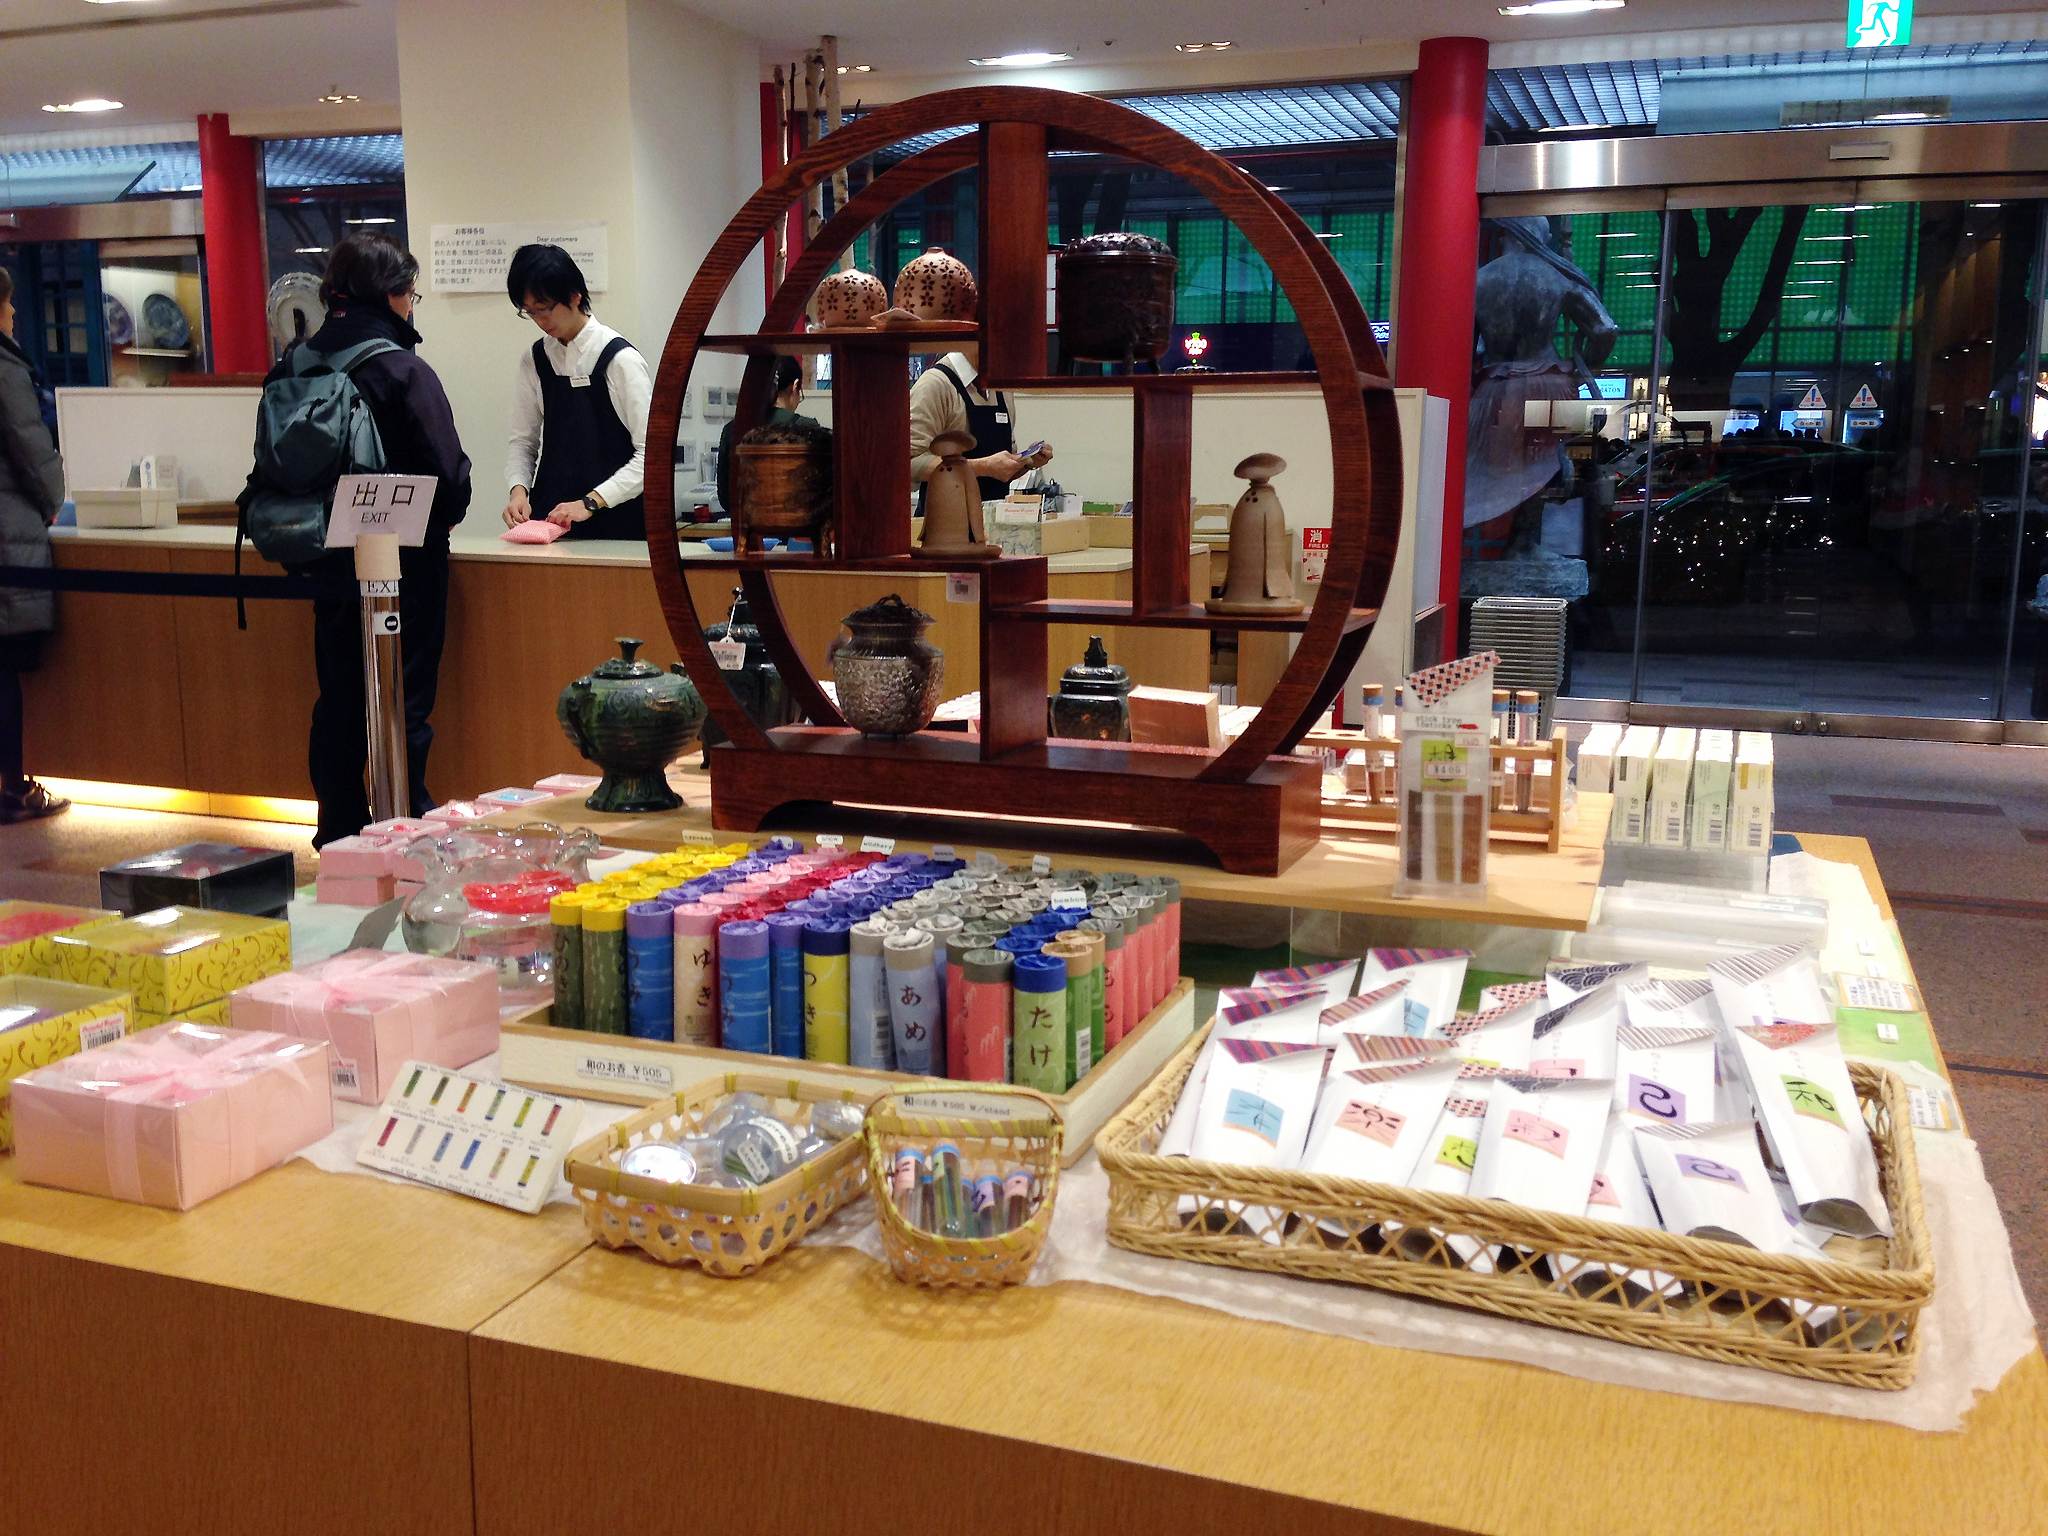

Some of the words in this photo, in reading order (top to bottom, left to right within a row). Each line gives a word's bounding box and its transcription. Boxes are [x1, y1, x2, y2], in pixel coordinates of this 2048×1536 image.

[351, 481, 416, 508] 出口
[360, 512, 391, 524] EXIT
[1310, 529, 1323, 543] 消
[693, 948, 712, 1008] ゆき
[900, 984, 927, 1042] あめ
[1029, 1006, 1053, 1068] たけ
